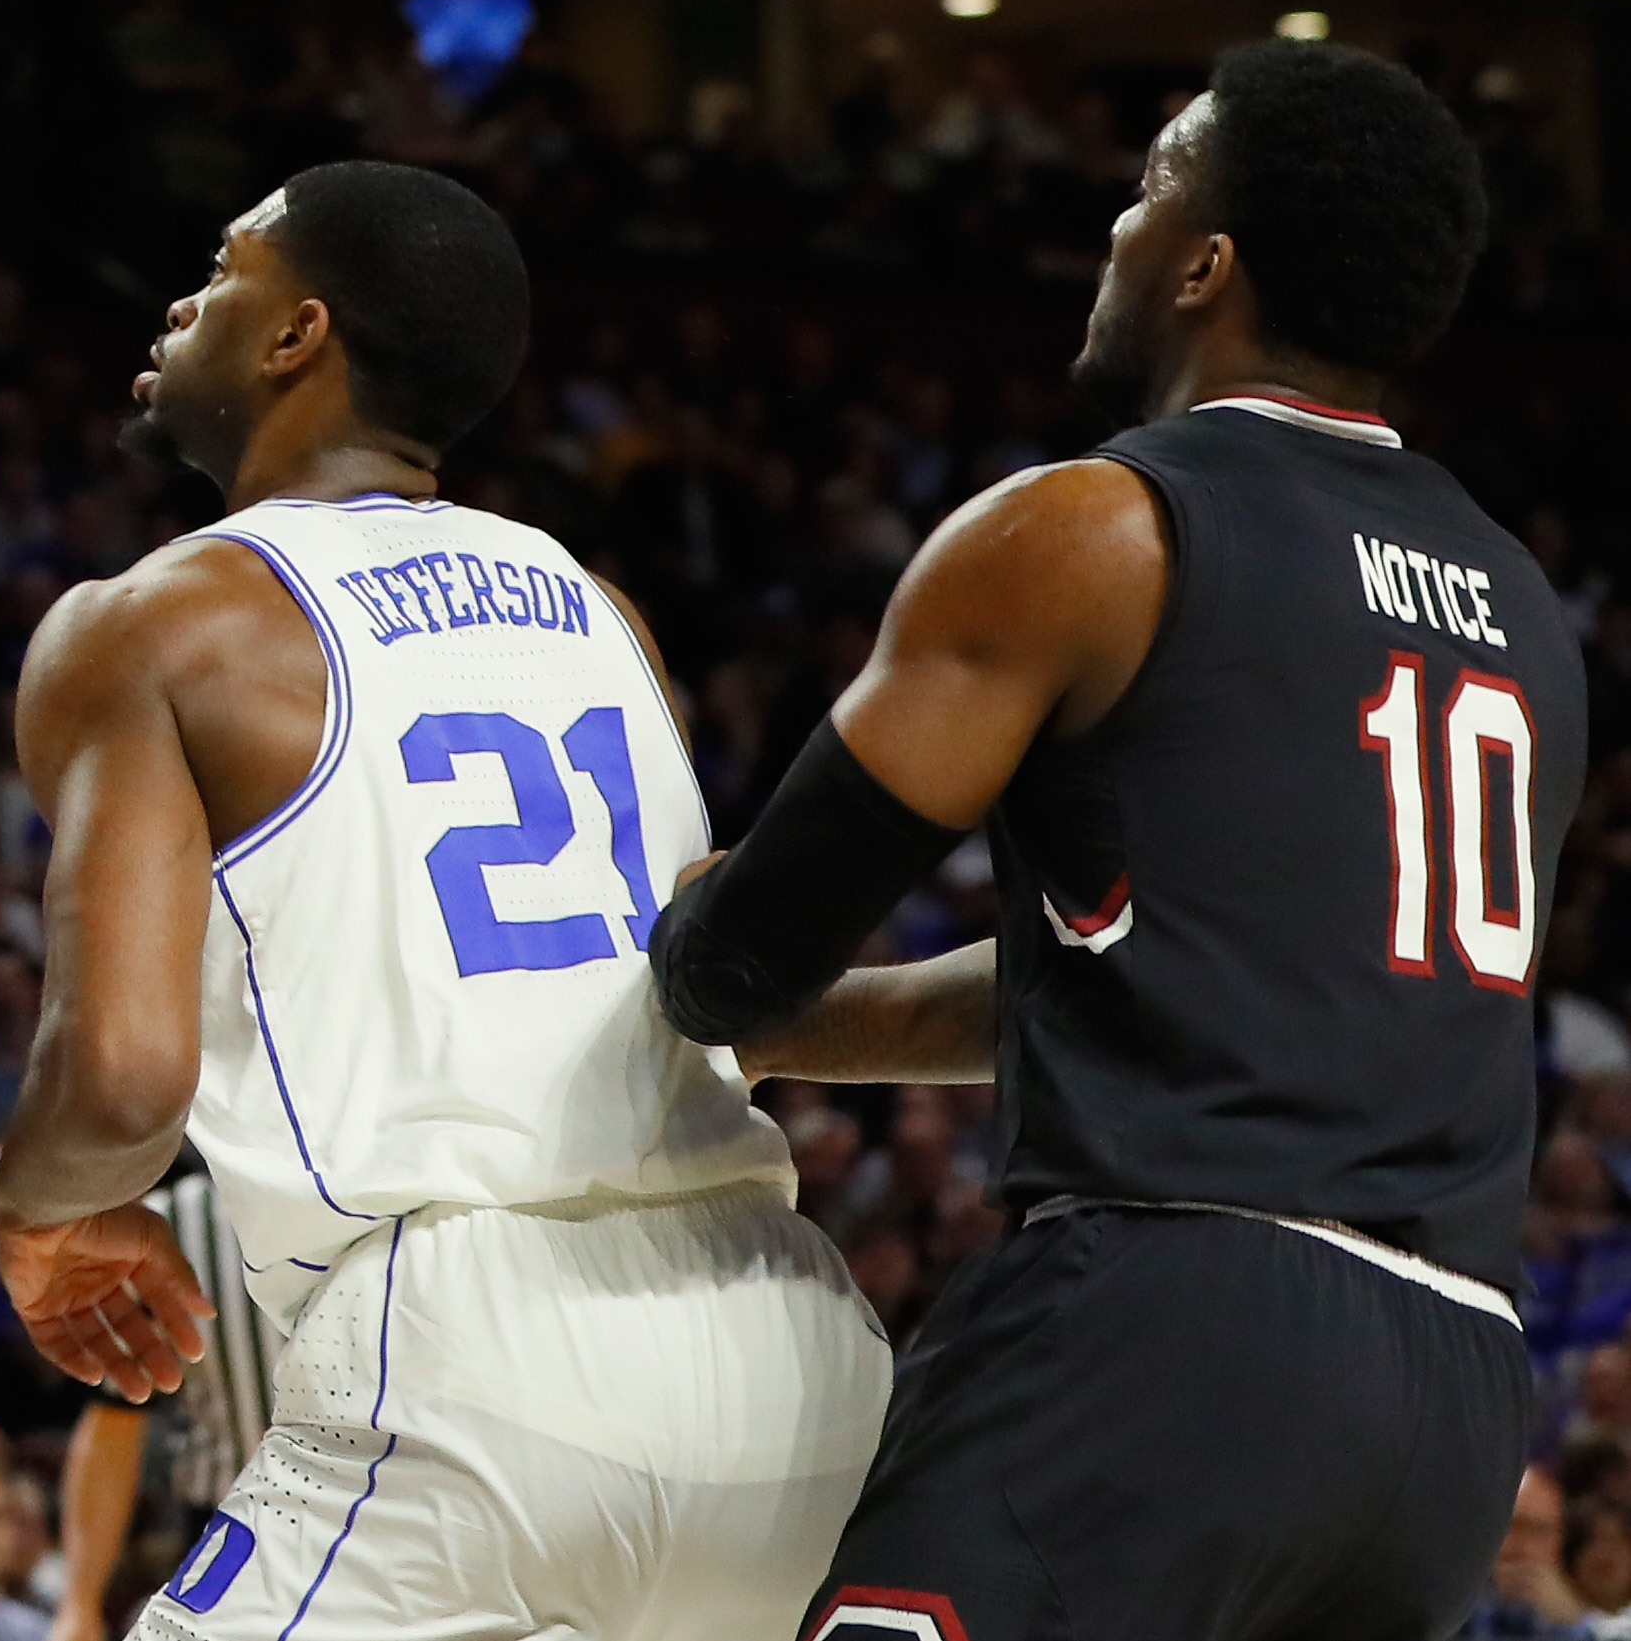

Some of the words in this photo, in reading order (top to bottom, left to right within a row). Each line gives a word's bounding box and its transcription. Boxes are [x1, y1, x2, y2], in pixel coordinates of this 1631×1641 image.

[335, 551, 591, 647] JEFFERSON
[1353, 532, 1508, 650] NOTICE
[399, 706, 661, 978] 21
[1359, 649, 1538, 997] 10
